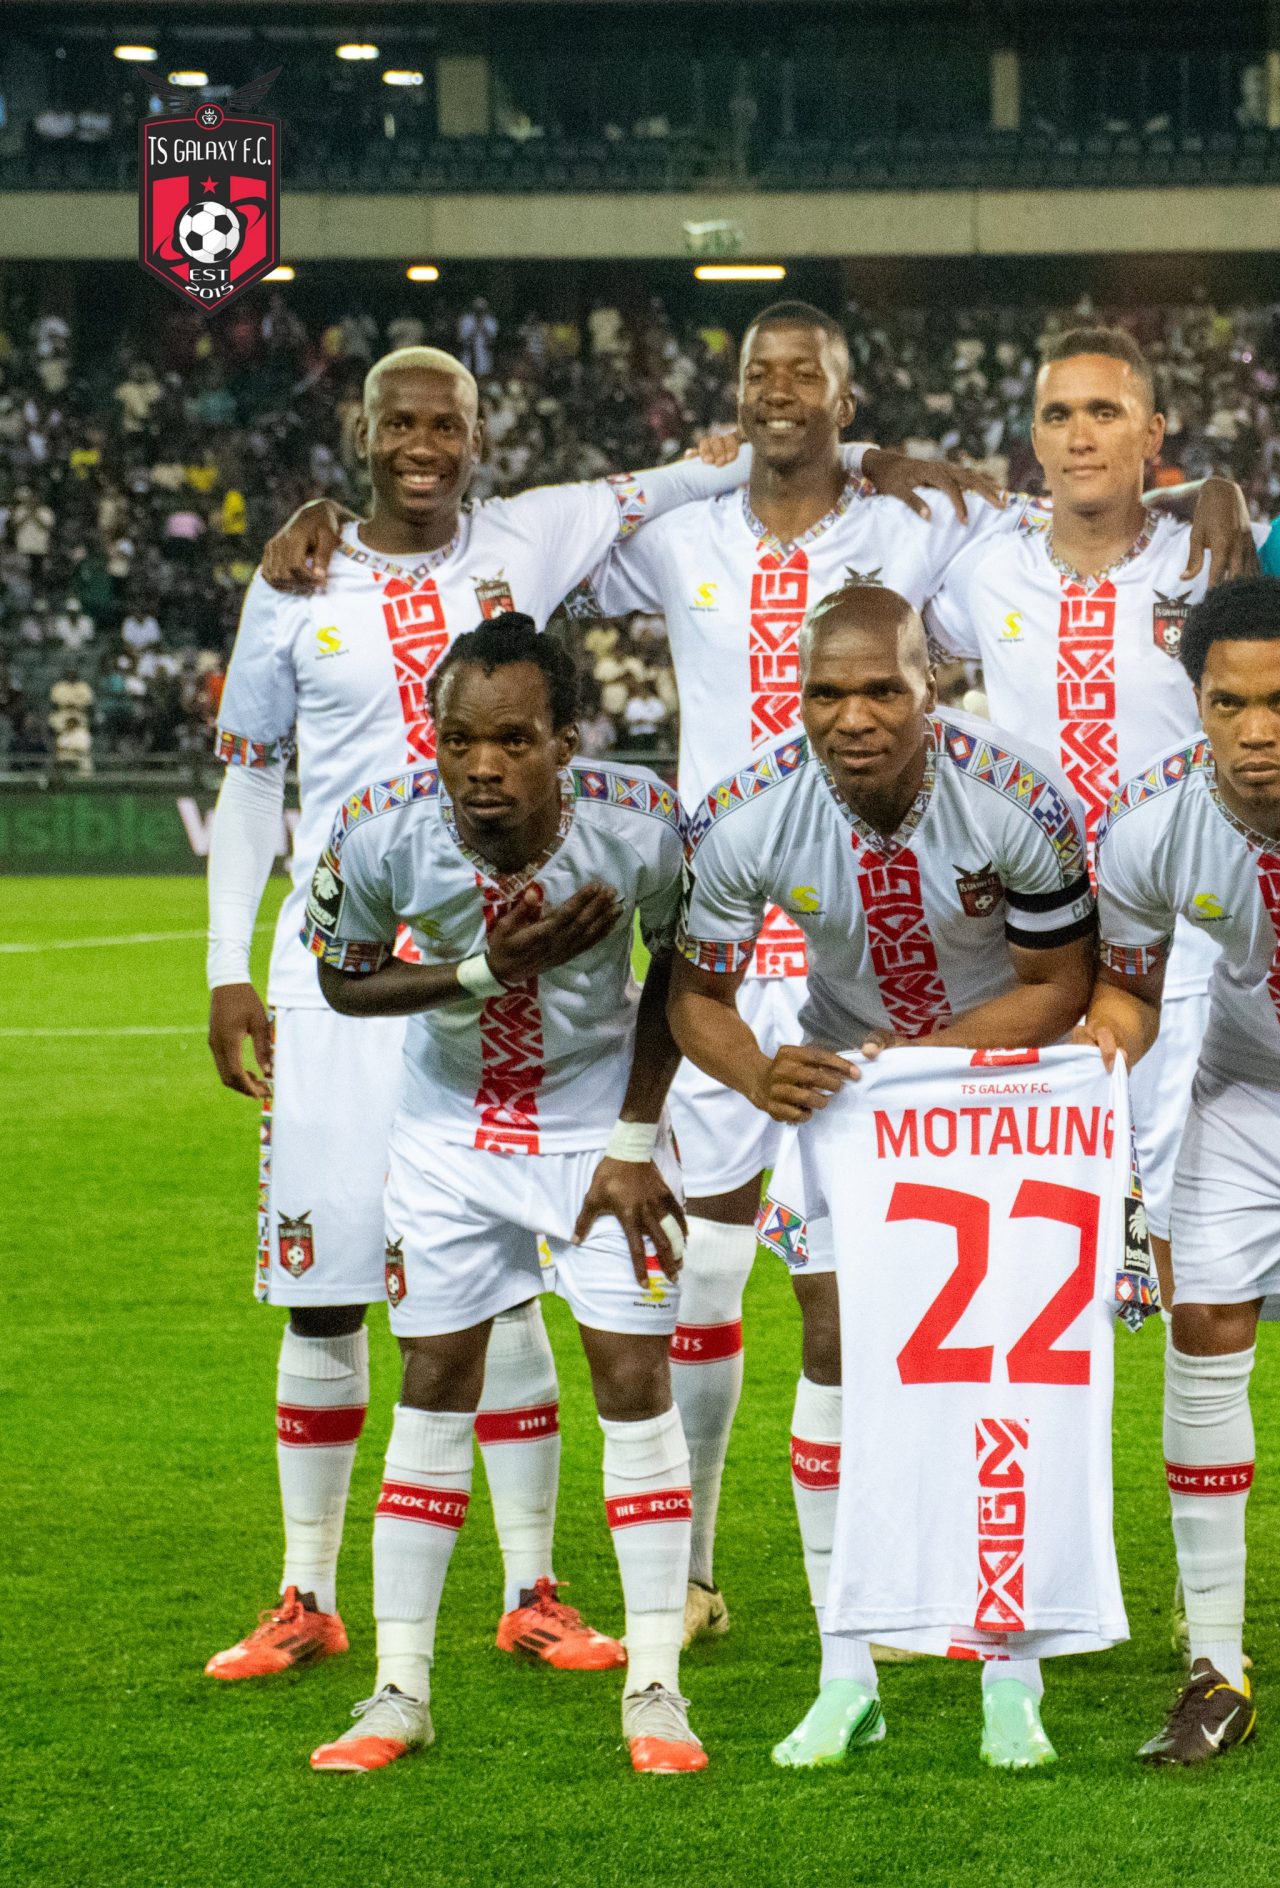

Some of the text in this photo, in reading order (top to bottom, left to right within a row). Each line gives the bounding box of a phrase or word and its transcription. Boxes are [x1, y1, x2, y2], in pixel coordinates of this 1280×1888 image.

[961, 1082, 1052, 1094] TS GALAXY F.C.
[885, 1178, 1101, 1386] 22
[794, 1452, 840, 1473] ROC
[1168, 1472, 1249, 1487] ROCKETS
[387, 1493, 467, 1518] ROCKETS
[615, 1502, 643, 1517] THE
